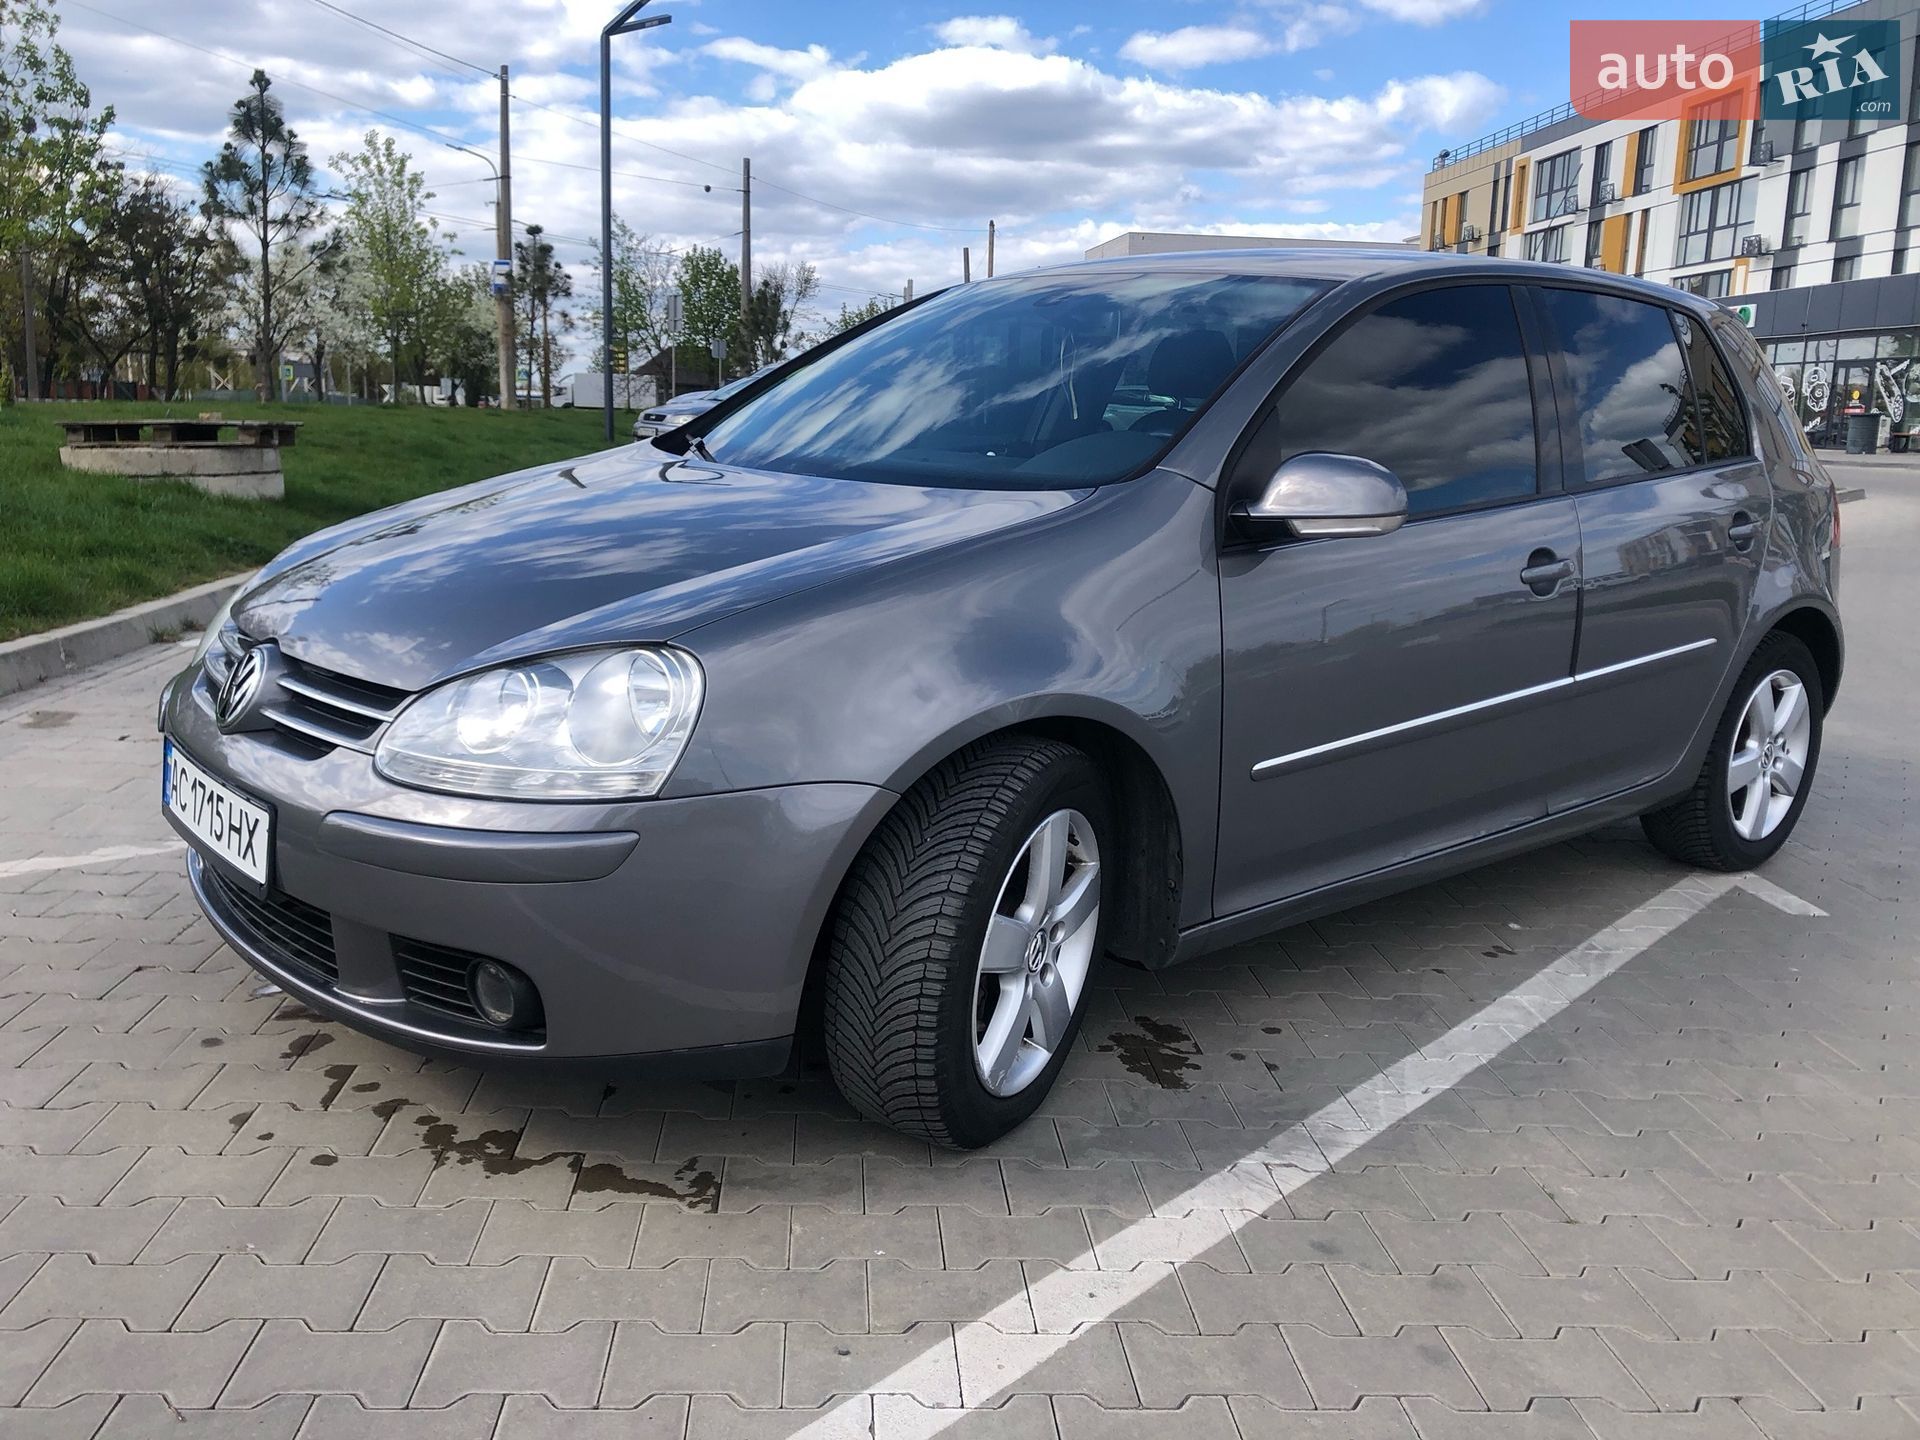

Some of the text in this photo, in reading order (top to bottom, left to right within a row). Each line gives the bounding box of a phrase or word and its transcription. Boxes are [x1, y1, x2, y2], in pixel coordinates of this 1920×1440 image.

[170, 758, 260, 868] AC 1715 HX
